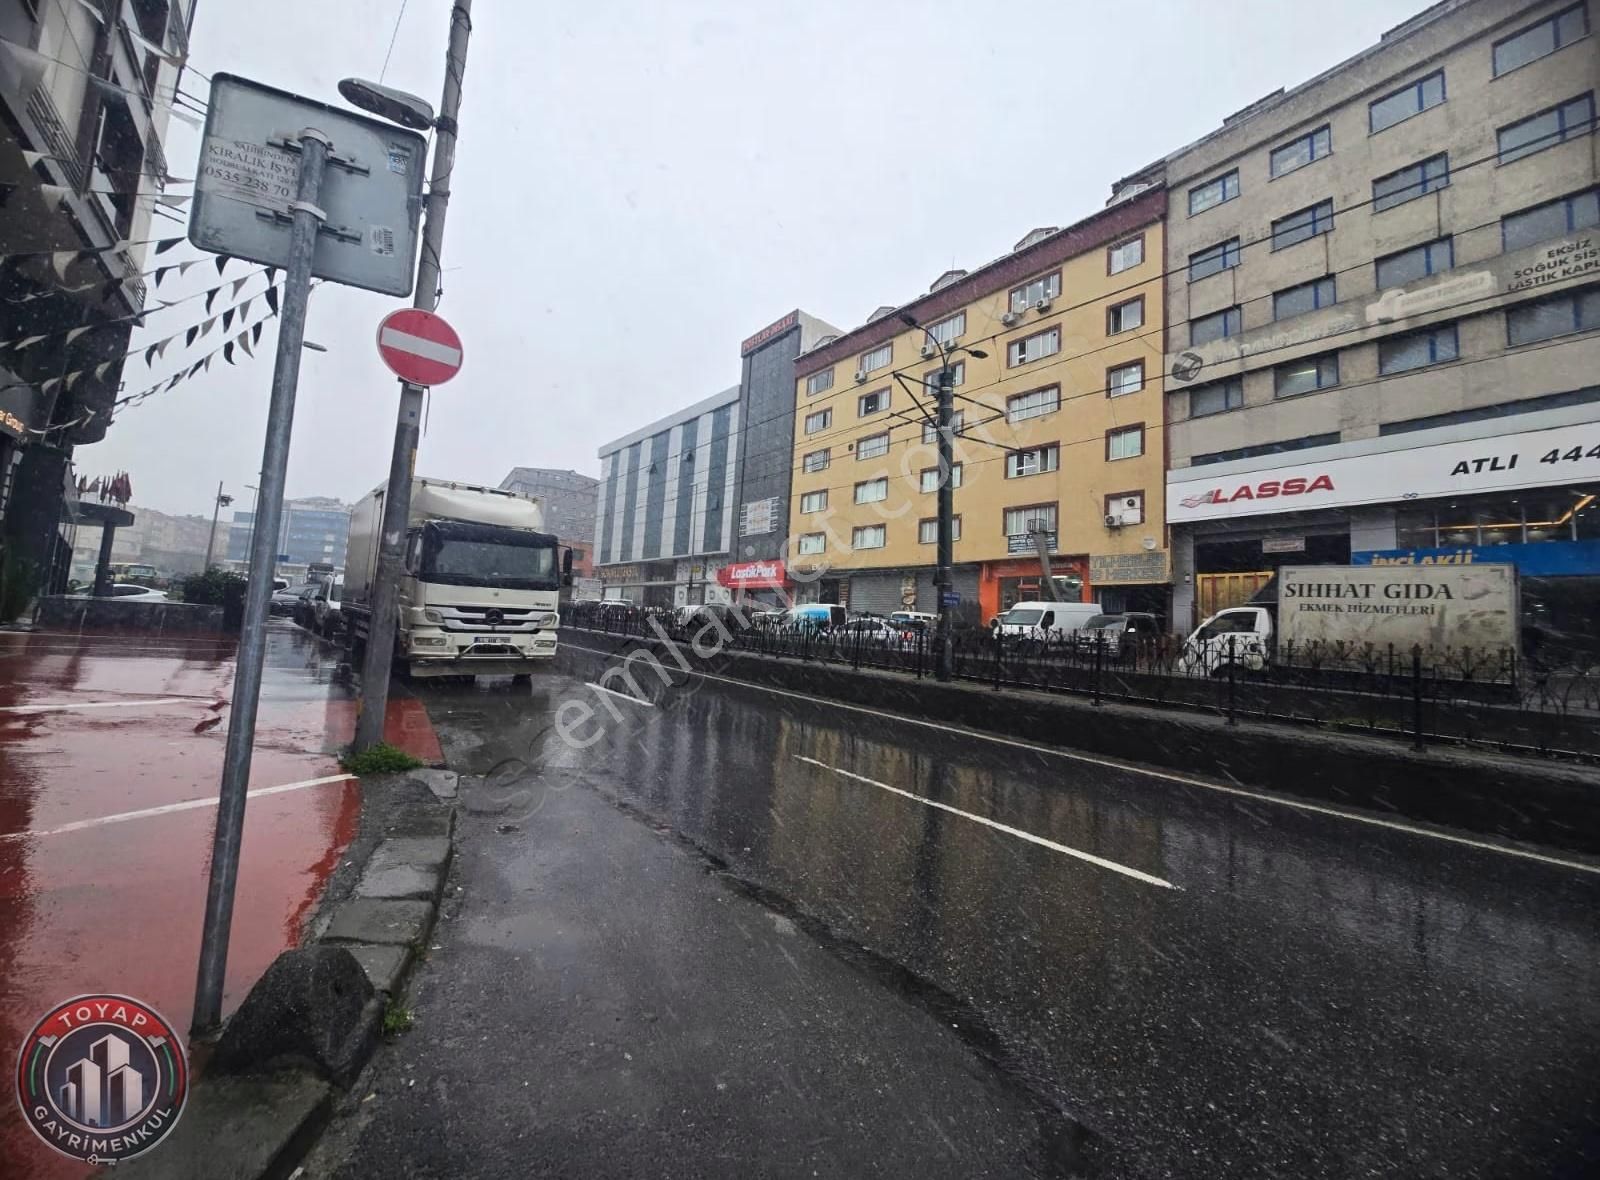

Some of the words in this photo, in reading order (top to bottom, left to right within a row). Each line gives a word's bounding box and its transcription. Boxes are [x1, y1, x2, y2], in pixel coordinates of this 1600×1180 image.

[204, 165, 241, 183] 0535
[272, 184, 290, 197] 70
[1514, 256, 1569, 279] SOĞUK
[1574, 247, 1600, 262] SİS
[1450, 454, 1519, 476] ATLI
[1211, 475, 1335, 503] LASSA
[1284, 583, 1376, 599] SIHHAT
[1383, 583, 1455, 600] GIDA
[1300, 602, 1344, 613] EKMEK
[1347, 602, 1436, 616] HİZMETLERİ
